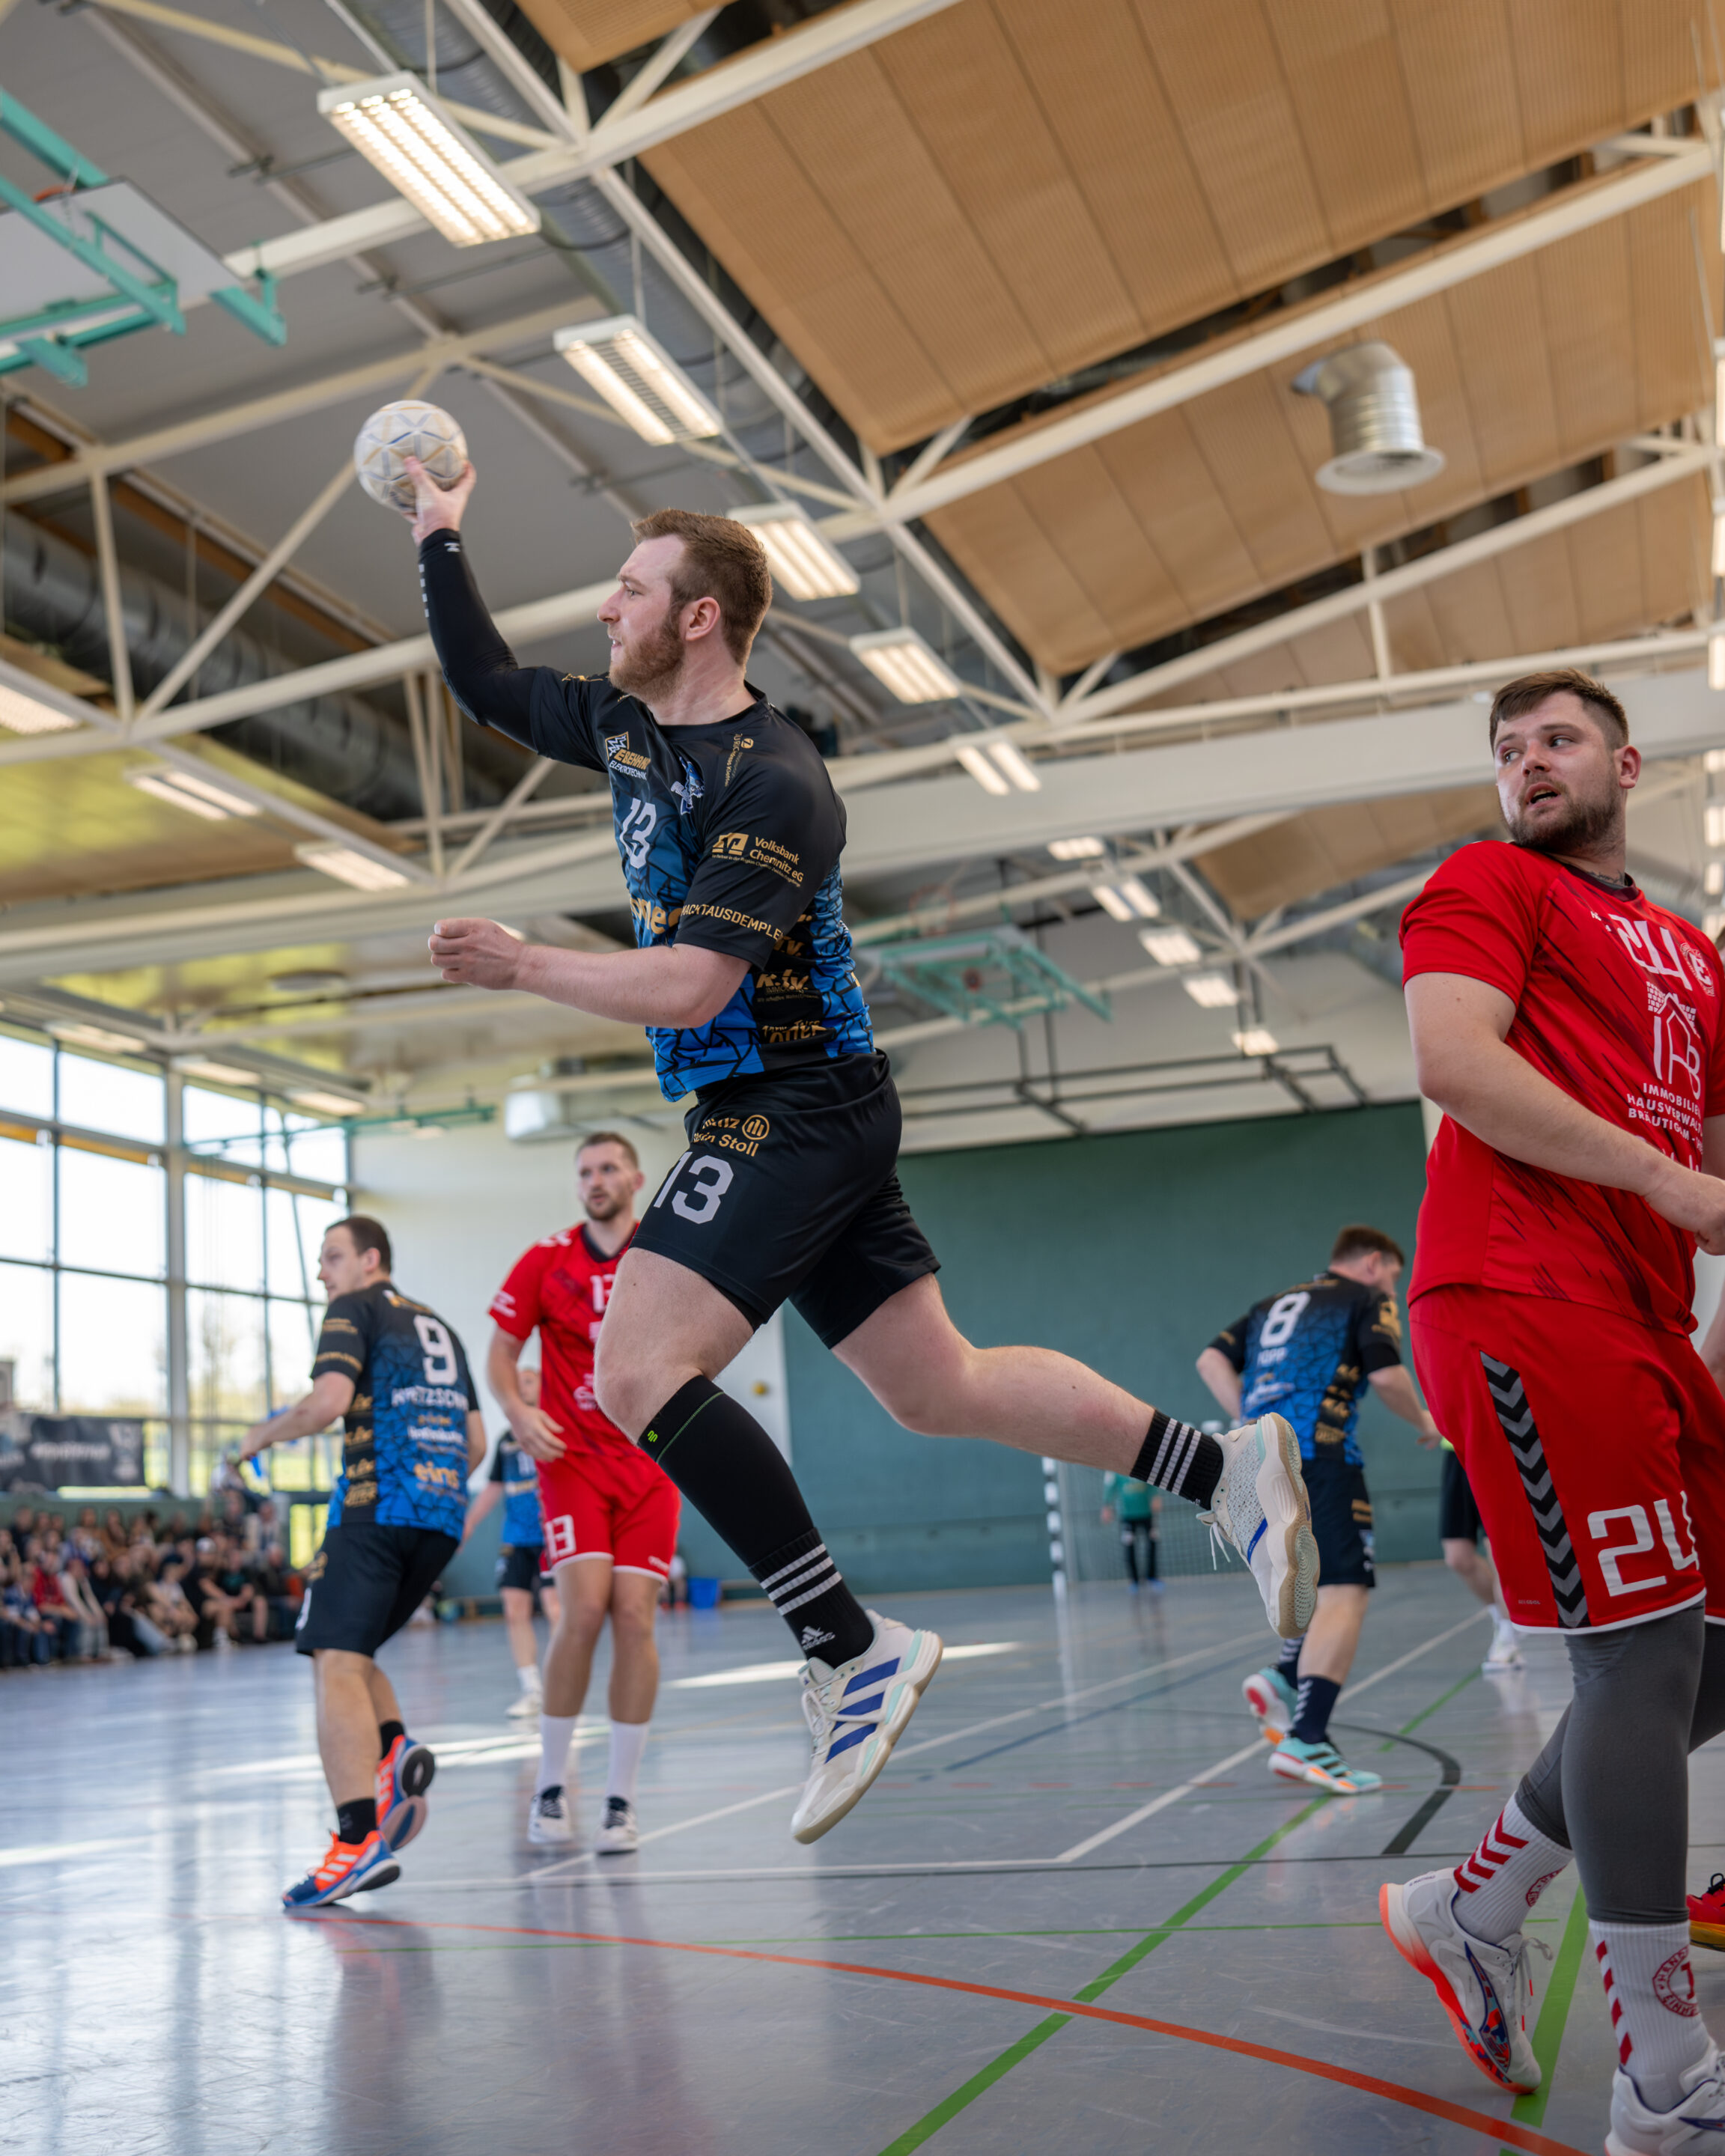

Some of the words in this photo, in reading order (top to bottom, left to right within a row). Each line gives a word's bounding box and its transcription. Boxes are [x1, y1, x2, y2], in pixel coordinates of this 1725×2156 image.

[609, 760, 647, 780] ELEKTROTECHNIK
[620, 797, 657, 869] 13
[755, 836, 800, 865] Volksbank
[749, 849, 792, 874] Chemnitz
[791, 870, 804, 883] eG
[1607, 913, 1693, 991] 24
[719, 1134, 759, 1157] Stoll
[1628, 1107, 1690, 1141] BRÄUTIGAM
[653, 1151, 734, 1225] 13
[1259, 1291, 1311, 1348] 8
[414, 1315, 458, 1385] 9
[544, 1514, 576, 1561] 13
[1587, 1490, 1700, 1597] 24
